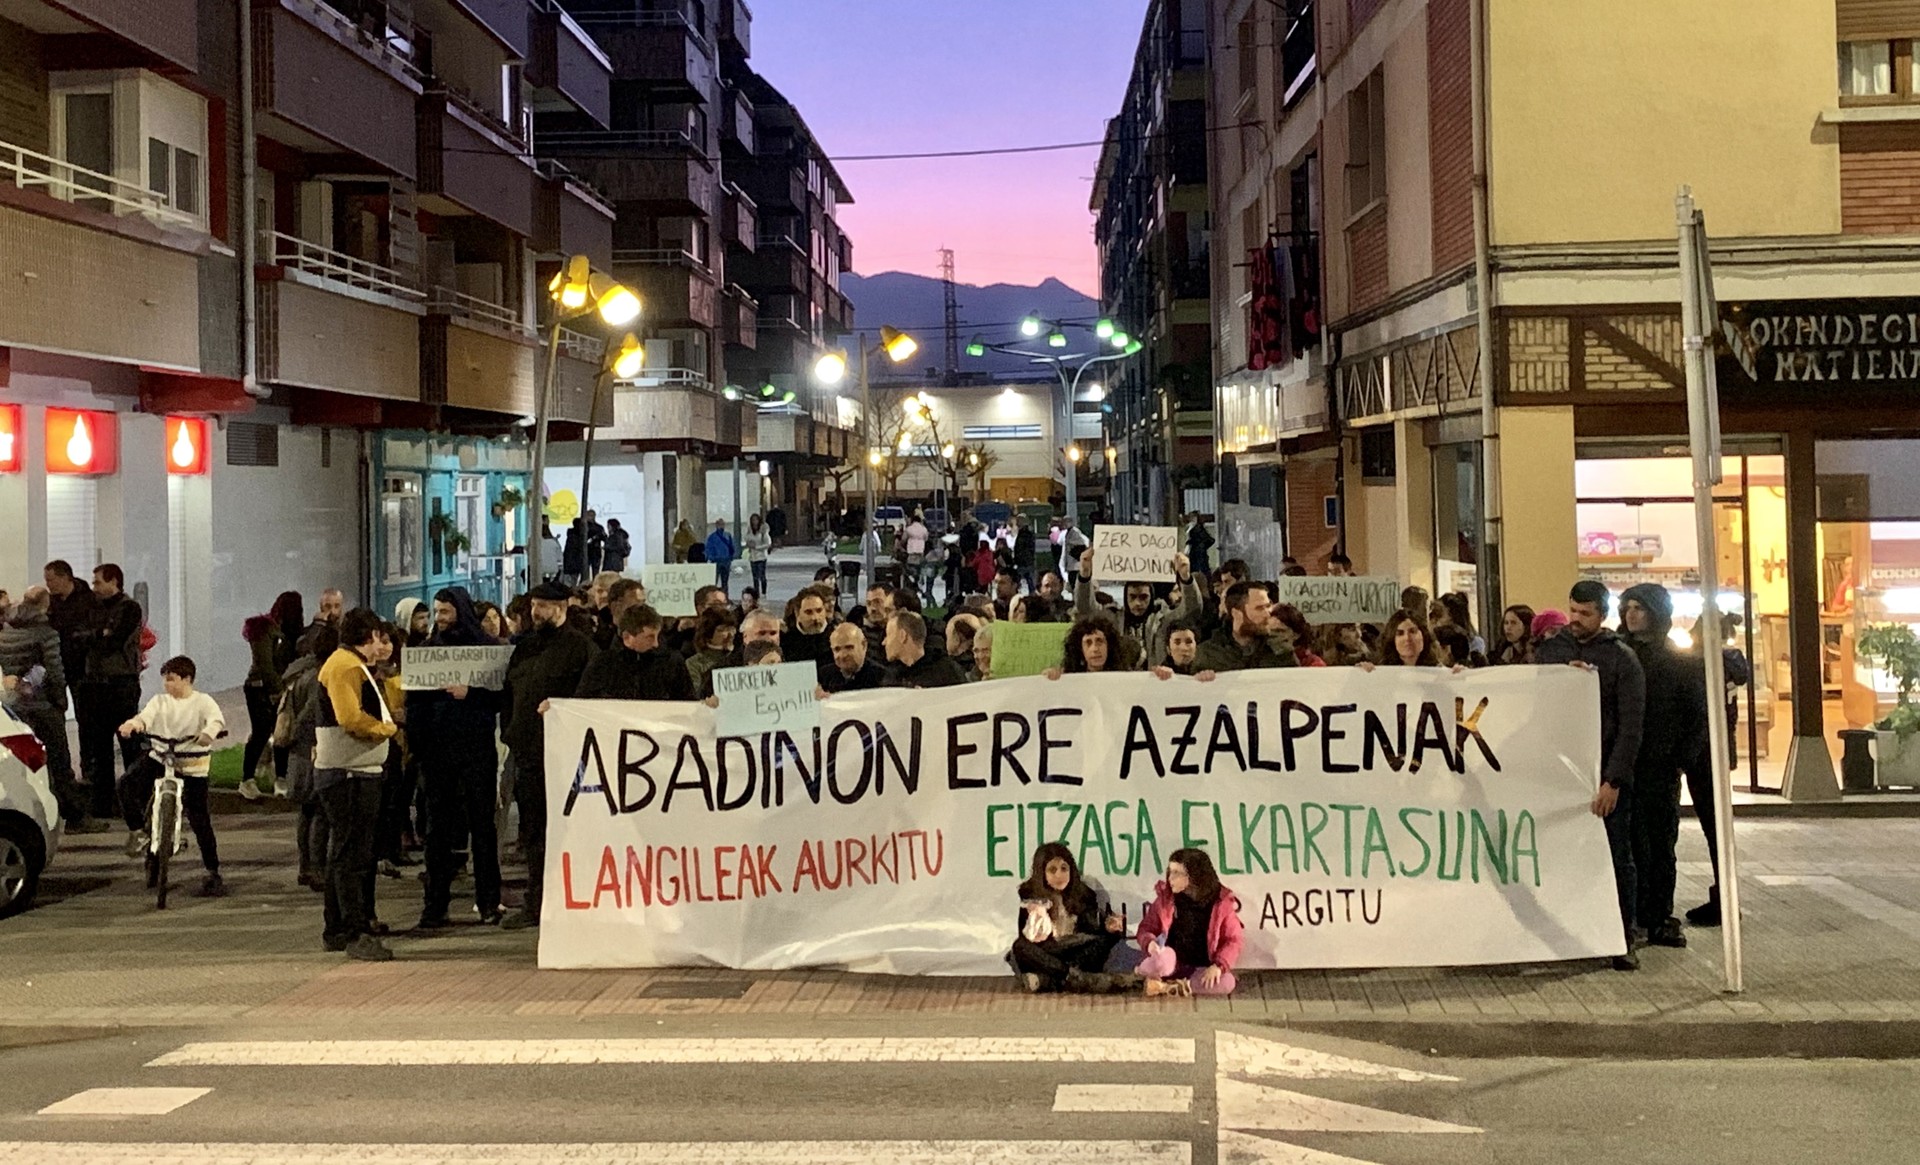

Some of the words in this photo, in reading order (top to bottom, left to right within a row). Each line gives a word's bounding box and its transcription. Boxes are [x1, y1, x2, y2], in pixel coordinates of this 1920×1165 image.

[1099, 532, 1132, 548] ZER
[1139, 533, 1176, 549] DAGO
[646, 588, 696, 604] GARBIT
[1284, 581, 1348, 598] JOAQUIN
[452, 647, 498, 661] GARBITU
[563, 716, 922, 816] ABADINON
[947, 711, 1084, 789] ERE
[1119, 697, 1501, 780] AZALPENAK
[986, 799, 1164, 879] EITZAGA
[1181, 799, 1541, 887] ELKARTASUNA
[562, 844, 782, 910] LANGILEAK
[793, 829, 944, 894] AURKITU
[1259, 888, 1382, 930] ARGITU
